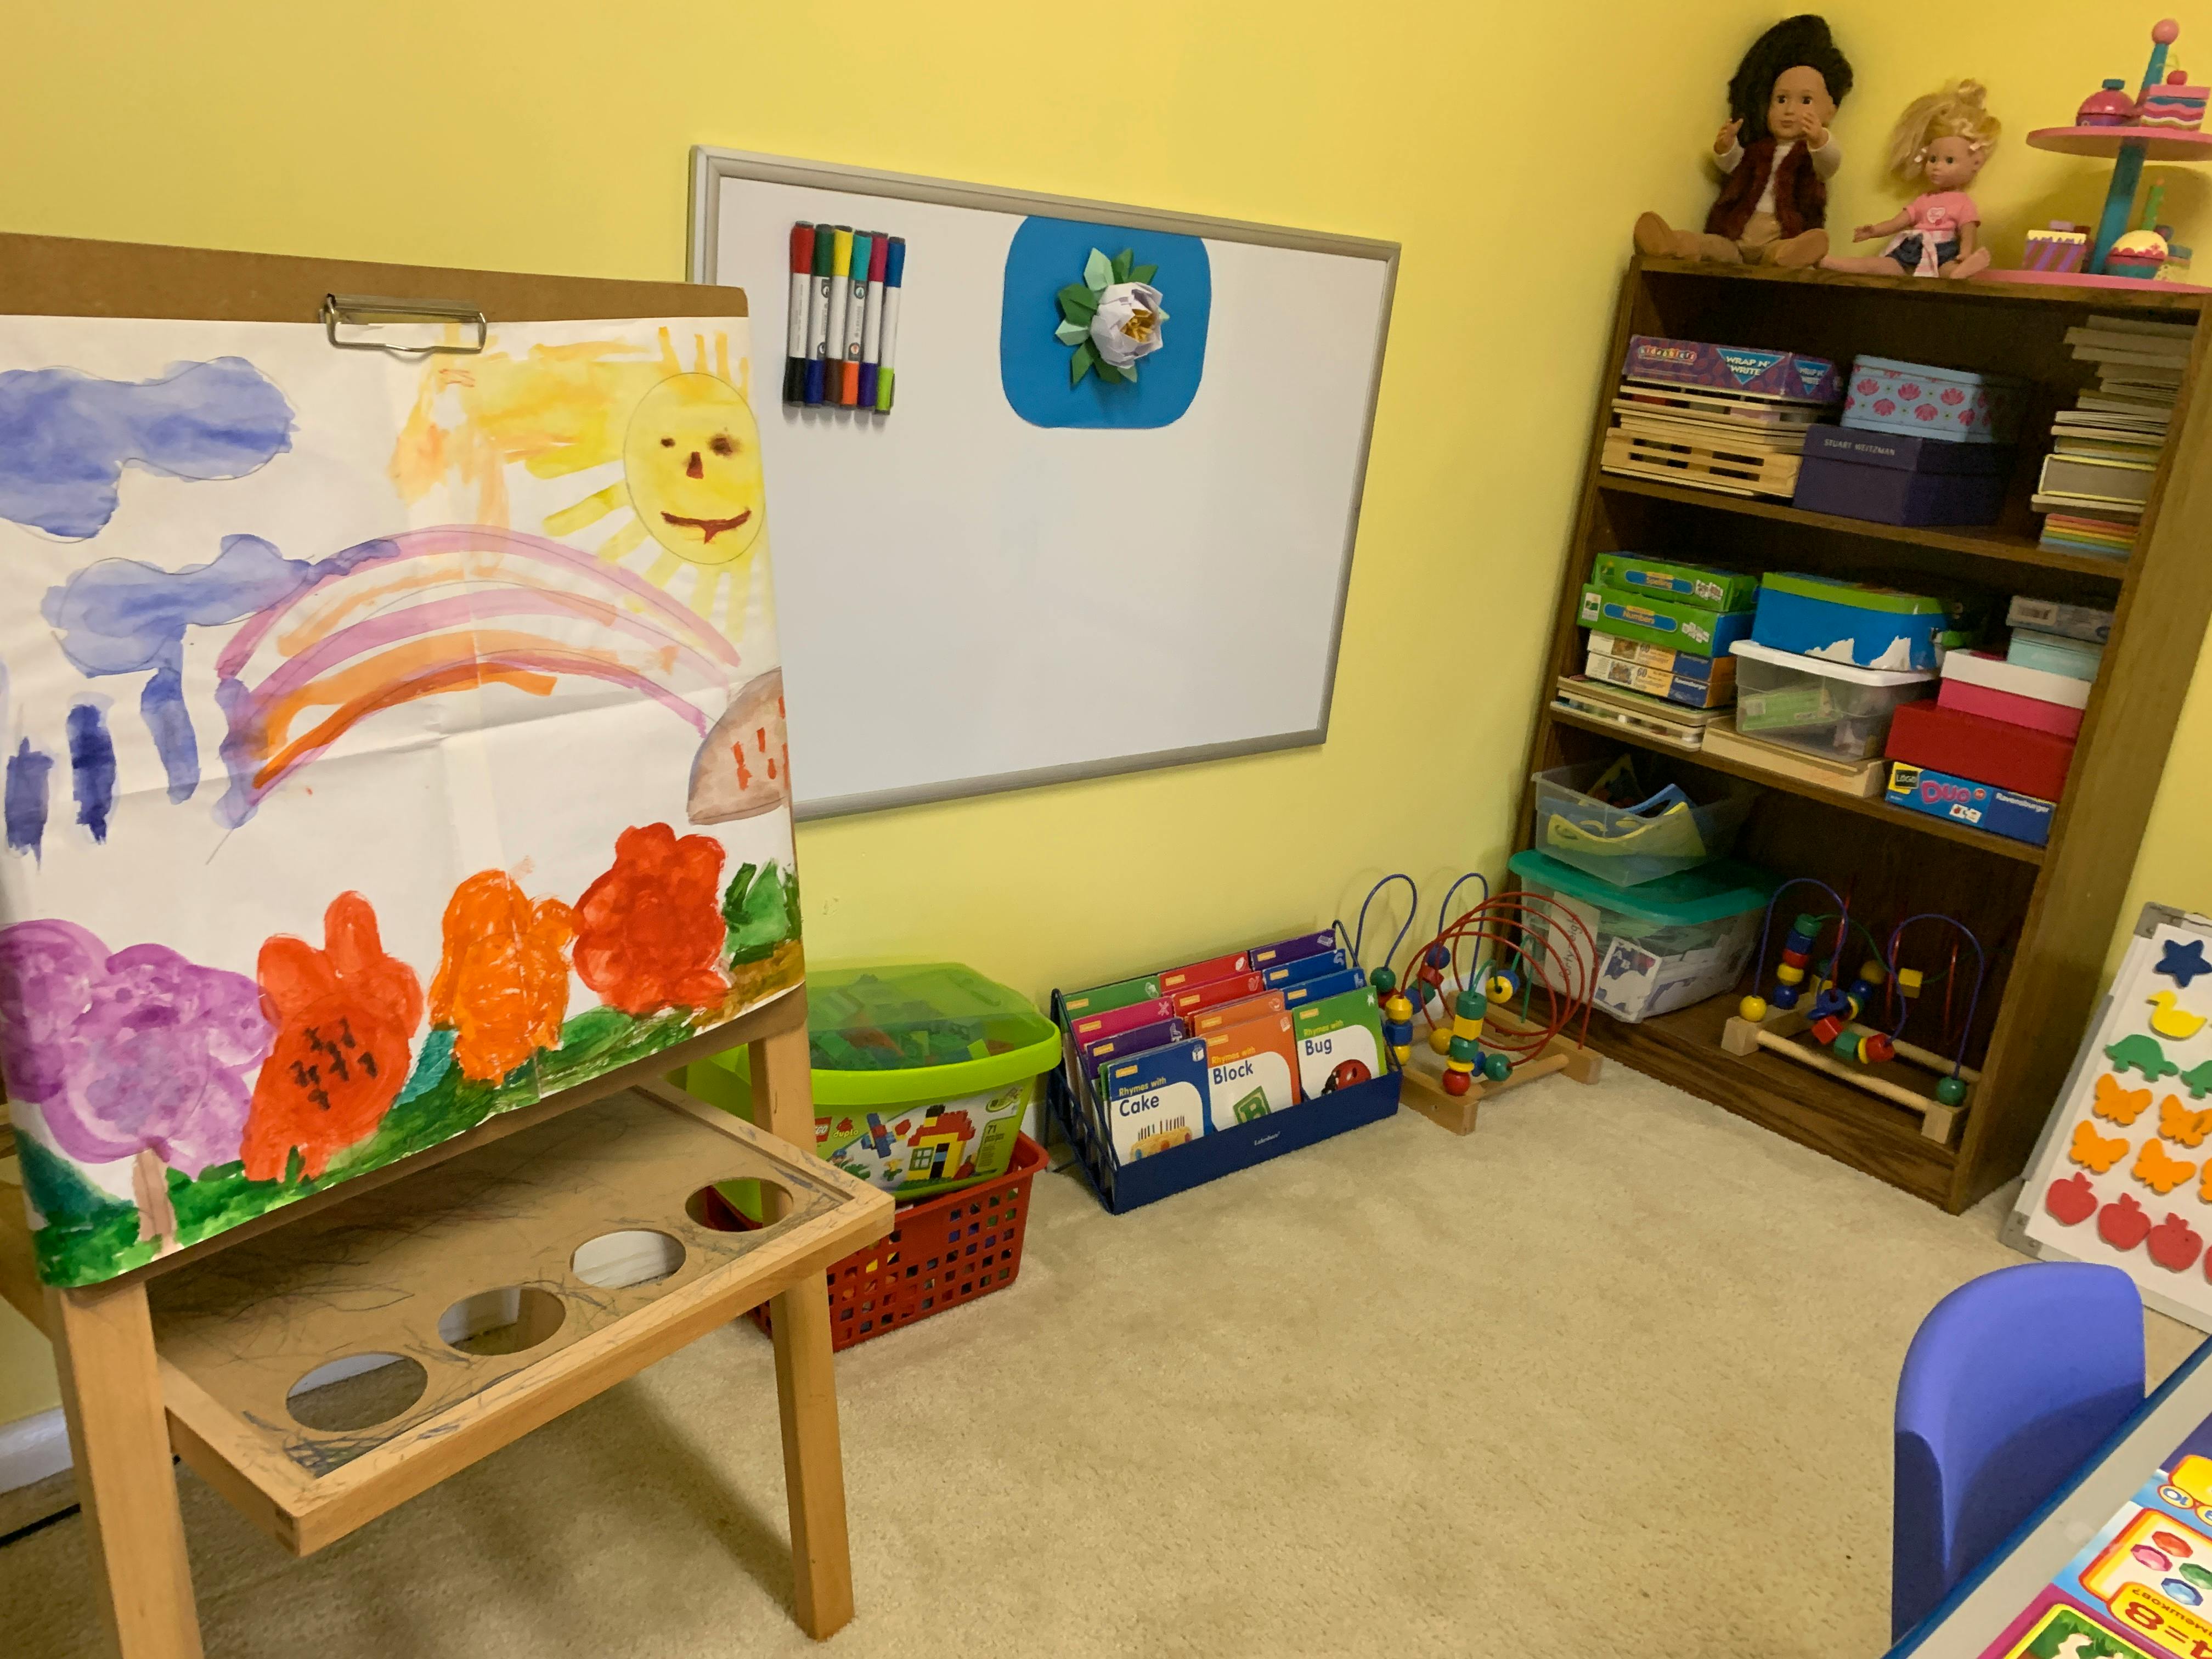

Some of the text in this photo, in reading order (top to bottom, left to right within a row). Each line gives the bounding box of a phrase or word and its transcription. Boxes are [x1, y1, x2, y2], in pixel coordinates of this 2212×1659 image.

[1726, 356, 1757, 366] WRAP
[1731, 365, 1760, 375] WRITE
[1824, 438, 1895, 456] STUART WEITZMAN
[1646, 577, 1673, 590] Spelling
[1623, 610, 1655, 624] Numbers
[1636, 667, 1648, 678] 60
[1304, 1019, 1344, 1037] Rhymes with
[1211, 1045, 1256, 1065] Rhymes with
[1305, 1038, 1332, 1056] Bug
[1213, 1059, 1254, 1085] Block
[1119, 1076, 1166, 1097] Rhymes with
[1119, 1094, 1160, 1117] Cake
[833, 1129, 859, 1138] duplo
[988, 1125, 997, 1134] 71
[2163, 1487, 2189, 1506] 10
